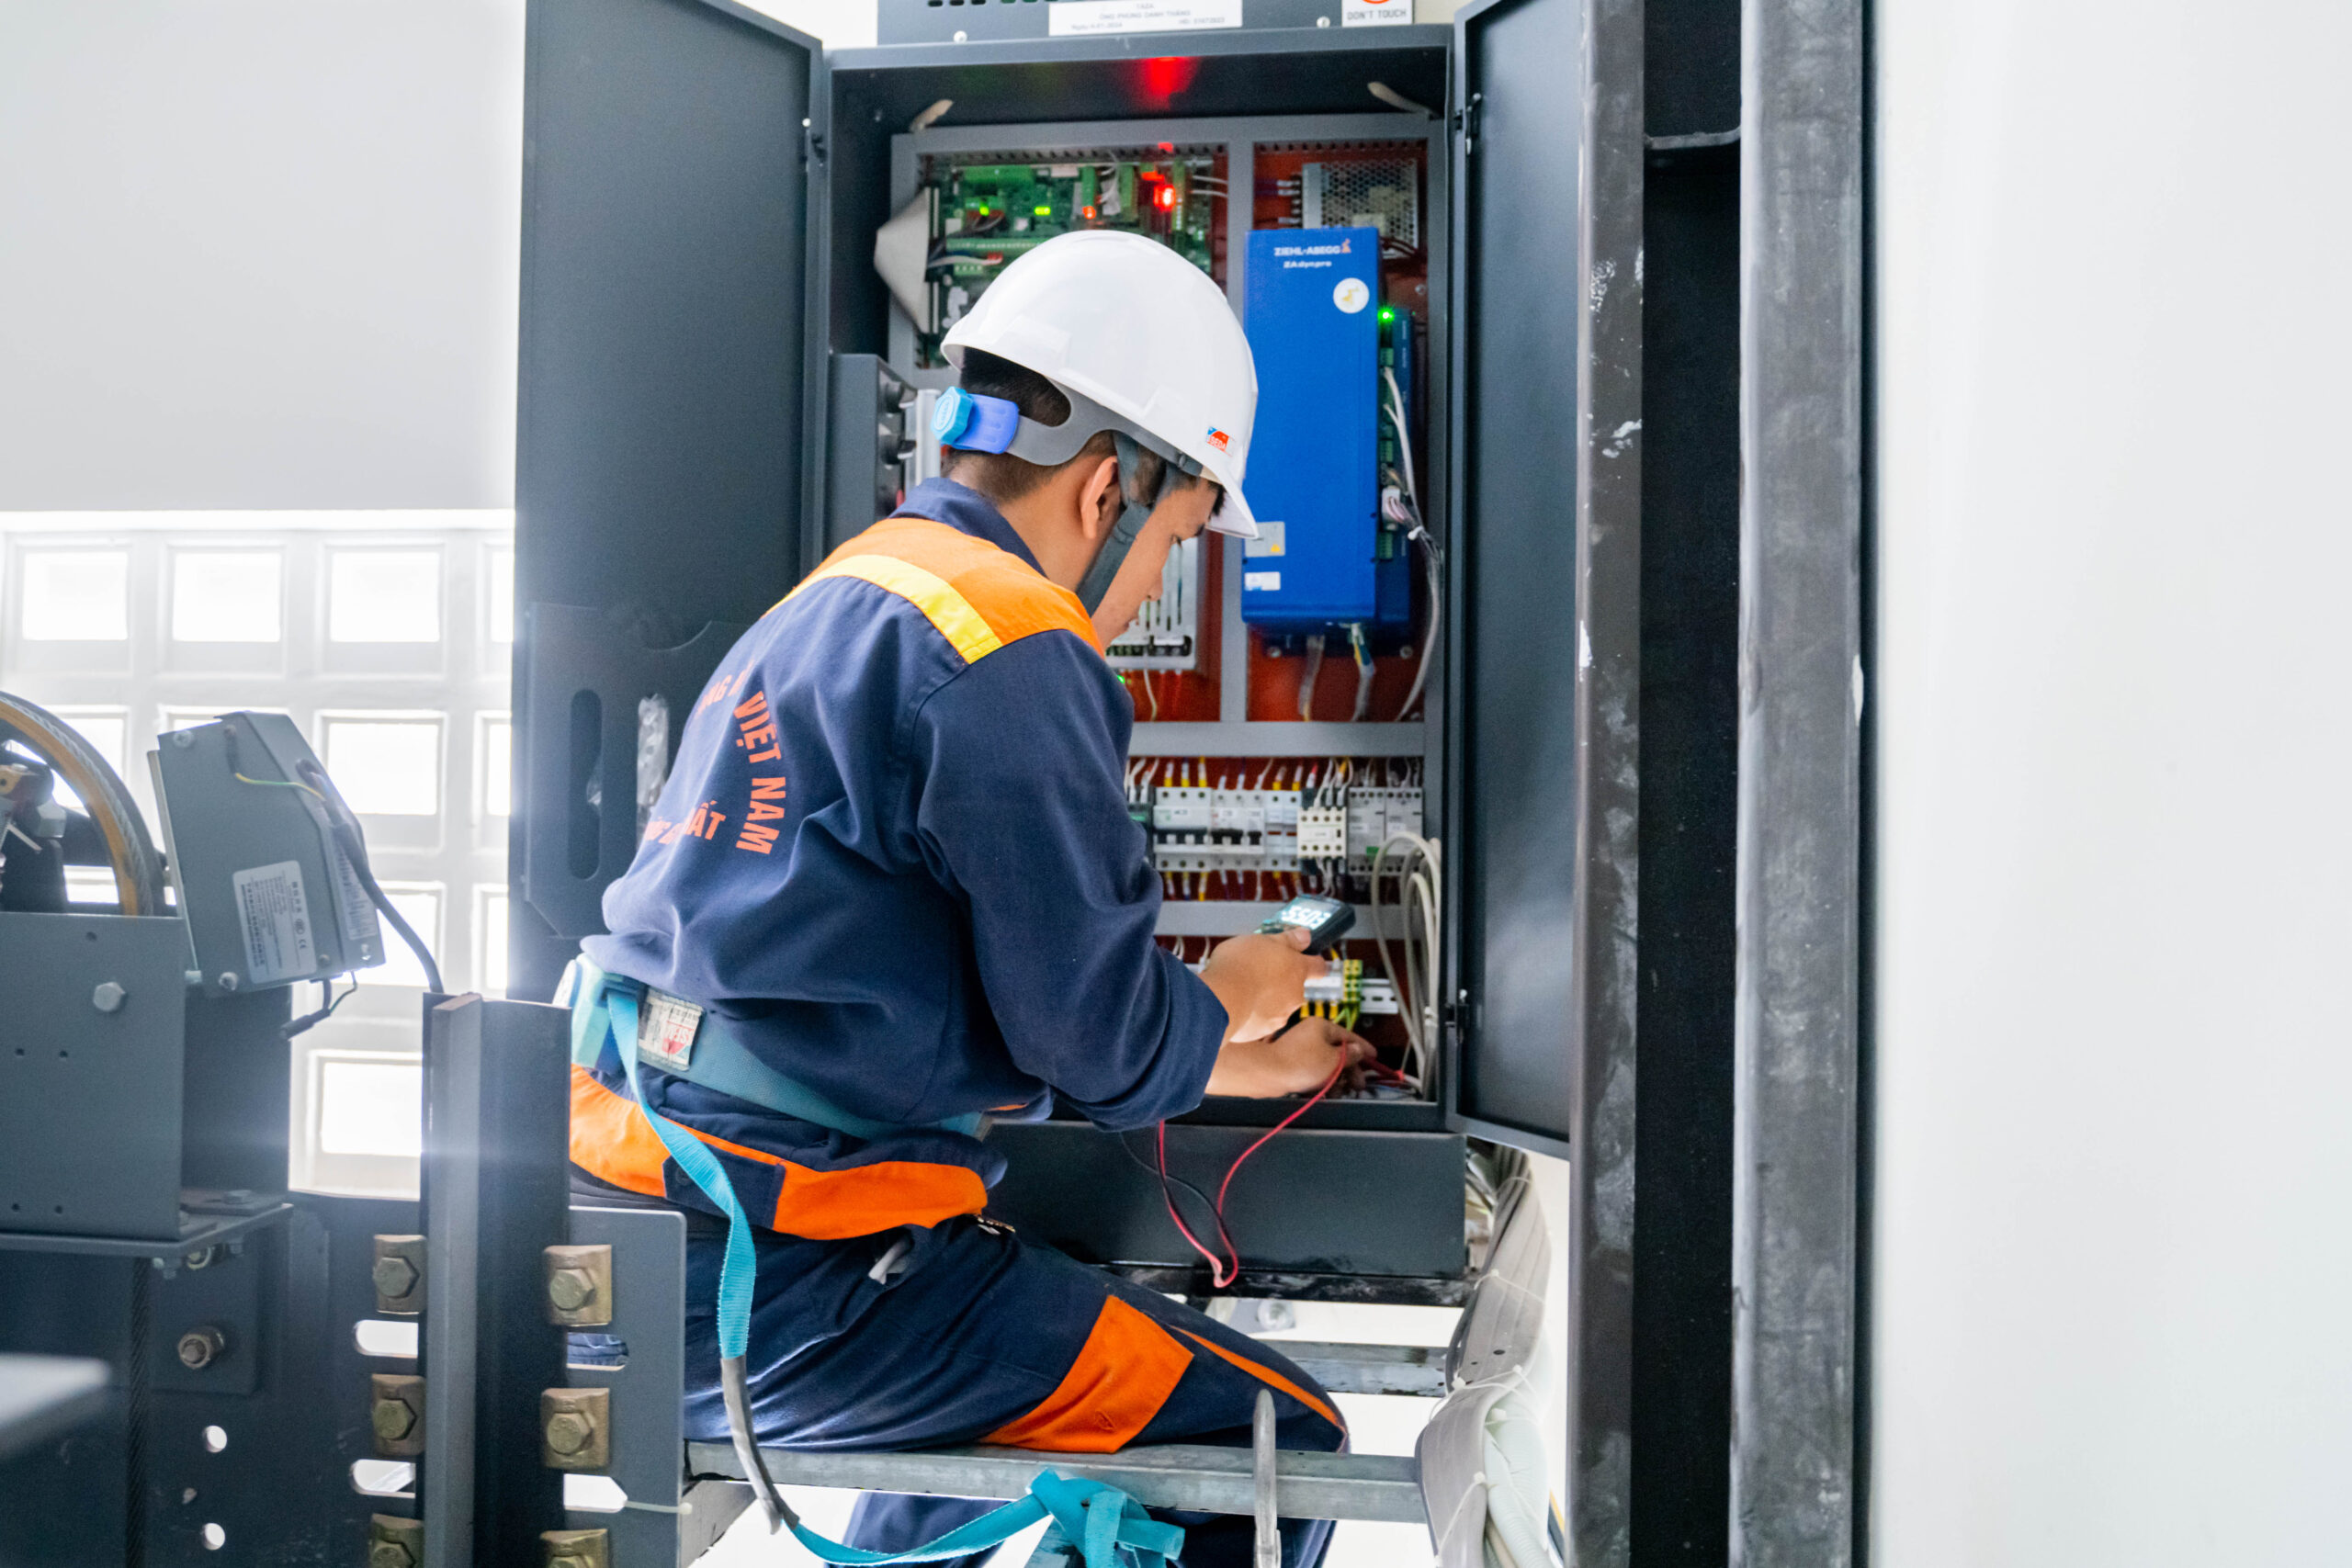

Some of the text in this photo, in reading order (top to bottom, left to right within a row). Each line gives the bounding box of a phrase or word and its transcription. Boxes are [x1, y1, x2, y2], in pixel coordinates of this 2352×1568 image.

[1346, 9, 1408, 20] DON'T TOUCH
[1273, 244, 1341, 257] ZIEHL-ABEGG
[733, 691, 786, 855] VIỆT NAM
